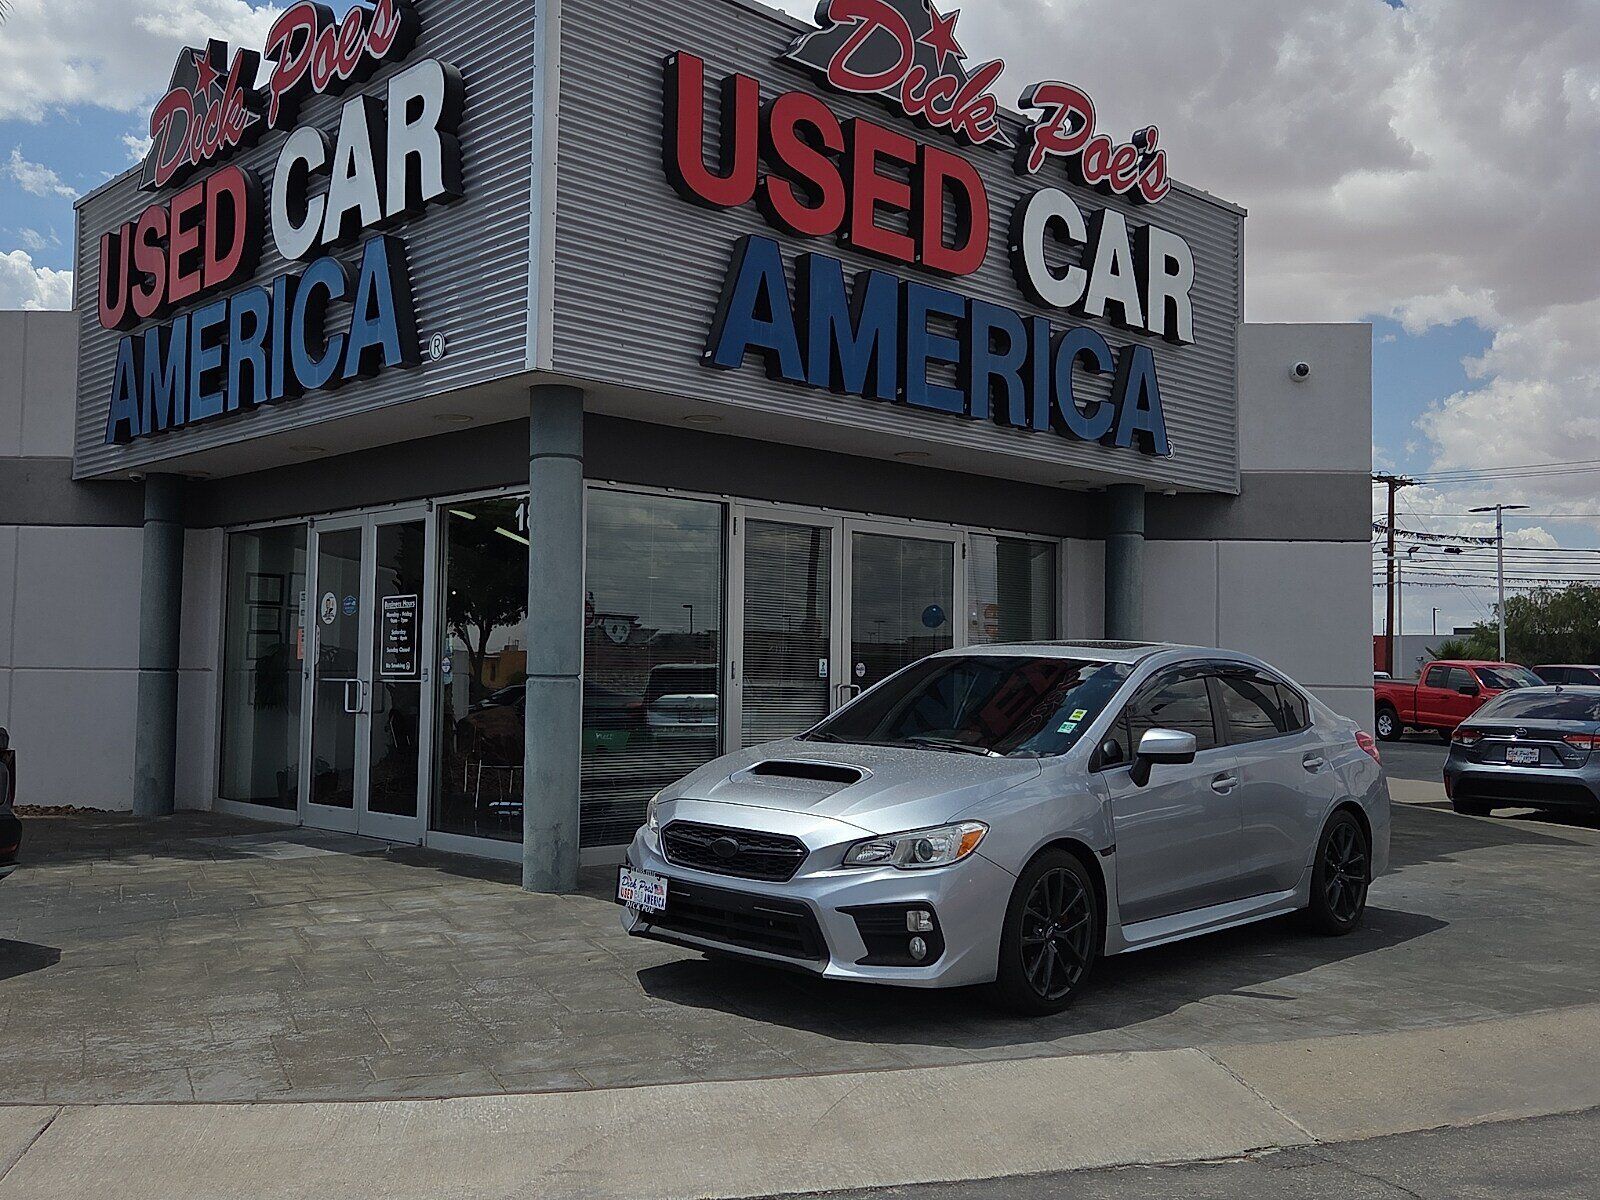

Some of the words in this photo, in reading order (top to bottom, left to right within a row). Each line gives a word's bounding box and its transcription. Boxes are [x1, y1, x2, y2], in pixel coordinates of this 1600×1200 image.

[98, 164, 248, 331] USED
[270, 58, 447, 261] CAR
[149, 45, 258, 188] Dick
[676, 50, 990, 277] USED
[1022, 187, 1197, 346] CAR
[822, 0, 1005, 146] Dick
[1025, 80, 1172, 205] Poe's
[105, 234, 404, 445] AMERICA
[712, 233, 1172, 457] AMERICA
[515, 502, 530, 531] 1
[621, 887, 633, 899] USED
[644, 893, 665, 908] AMERICA
